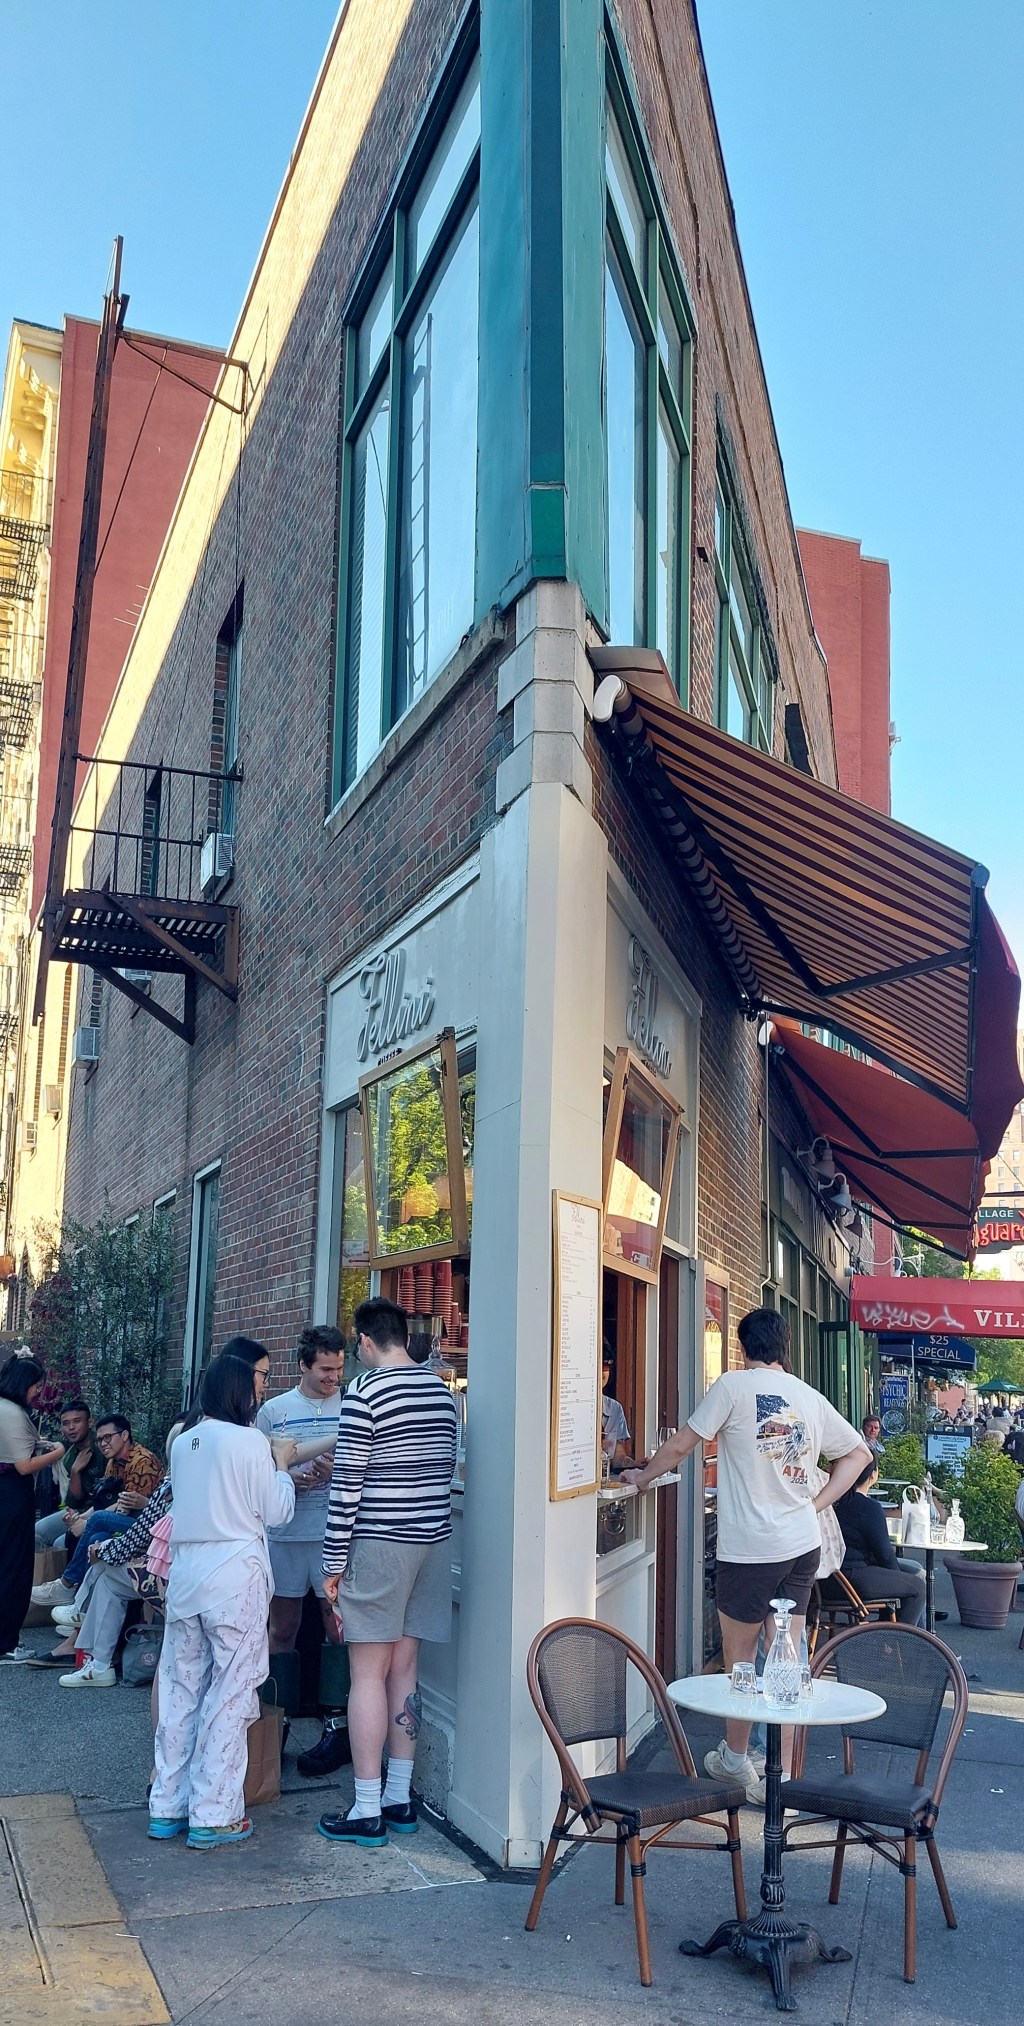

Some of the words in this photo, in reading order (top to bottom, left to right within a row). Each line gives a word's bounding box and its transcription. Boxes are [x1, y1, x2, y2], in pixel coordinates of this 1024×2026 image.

[356, 948, 435, 1062] Fellini
[979, 1222, 1024, 1246] guar
[973, 1309, 1024, 1328] VIL
[929, 1335, 949, 1345] $25
[917, 1346, 961, 1360] SPECIAL
[882, 1384, 907, 1397] PSYCHIC
[790, 1477, 808, 1485] 2024
